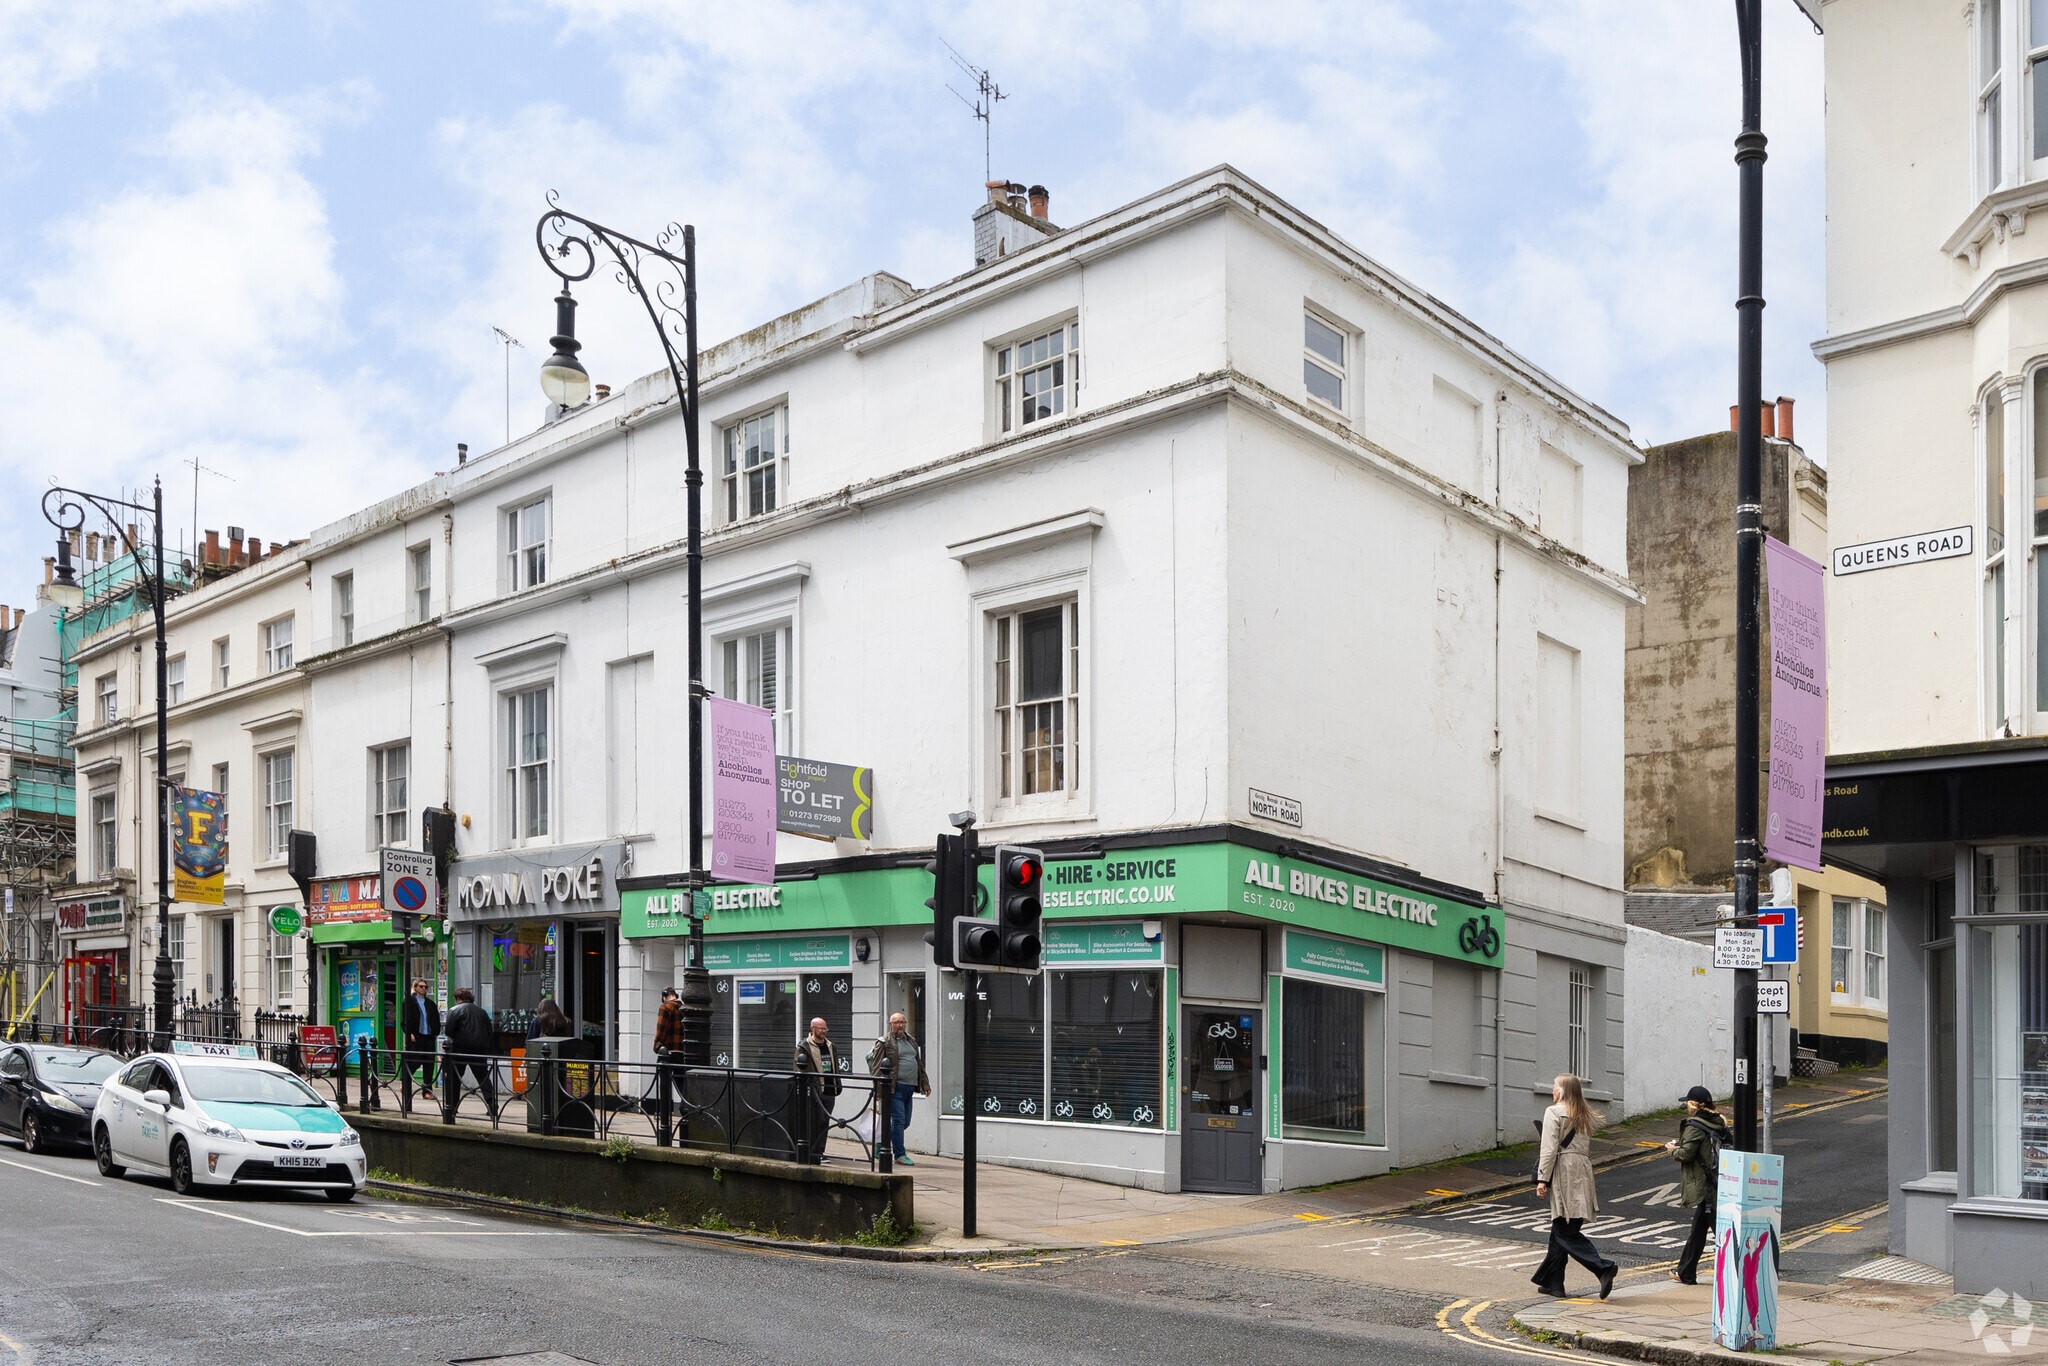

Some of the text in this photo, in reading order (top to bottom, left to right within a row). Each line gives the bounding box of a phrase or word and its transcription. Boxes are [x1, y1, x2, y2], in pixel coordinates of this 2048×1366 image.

[1841, 535, 1964, 567] QUEENS ROAD
[1772, 588, 1818, 622] If you think
[1773, 606, 1821, 639] you need us,
[1774, 621, 1815, 650] we're here
[1774, 636, 1783, 650] to
[1775, 650, 1814, 679] Alcoholics
[1775, 665, 1822, 698] Anonymous.
[716, 724, 766, 743] If you think
[1774, 718, 1798, 741] 01273
[717, 735, 733, 744] you
[734, 738, 756, 749] need
[1774, 734, 1804, 760] 203343
[717, 752, 726, 760] to
[742, 746, 762, 759] here
[718, 760, 763, 775] Alcoholics
[1773, 758, 1793, 779] 0800
[718, 768, 772, 786] Anonymous.
[780, 778, 811, 791] SHOP
[780, 787, 844, 810] TO LET
[1833, 784, 1858, 796] Road
[718, 798, 747, 812] 01273
[1252, 800, 1278, 817] NORTH
[1280, 808, 1300, 823] ROAD
[718, 808, 754, 822] 203343
[789, 809, 842, 824] 01273 672999
[187, 810, 214, 846] F
[717, 820, 742, 833] 0800
[386, 852, 433, 865] Controlled
[386, 862, 433, 877] ZONE Z
[1056, 858, 1176, 885] HIRE SERVICE
[311, 880, 350, 905] LEYA
[457, 872, 535, 909] MOANA
[1043, 884, 1176, 909] ESELECTRIC.CO.UK
[1244, 859, 1438, 927] ALL BIKES ELECTRIC
[645, 894, 669, 915] ALL
[713, 886, 781, 911] ELECTRIC
[1243, 891, 1295, 913] EST. 2020
[647, 918, 679, 929] EST. 2020
[1733, 930, 1756, 938] loading
[948, 991, 987, 1000] WHTE
[202, 1046, 231, 1056] TAXI
[1739, 1060, 1744, 1069] 1
[1737, 1072, 1745, 1083] 6
[279, 1156, 321, 1167] KH15 BZK
[1416, 1203, 1716, 1253] THROUG
